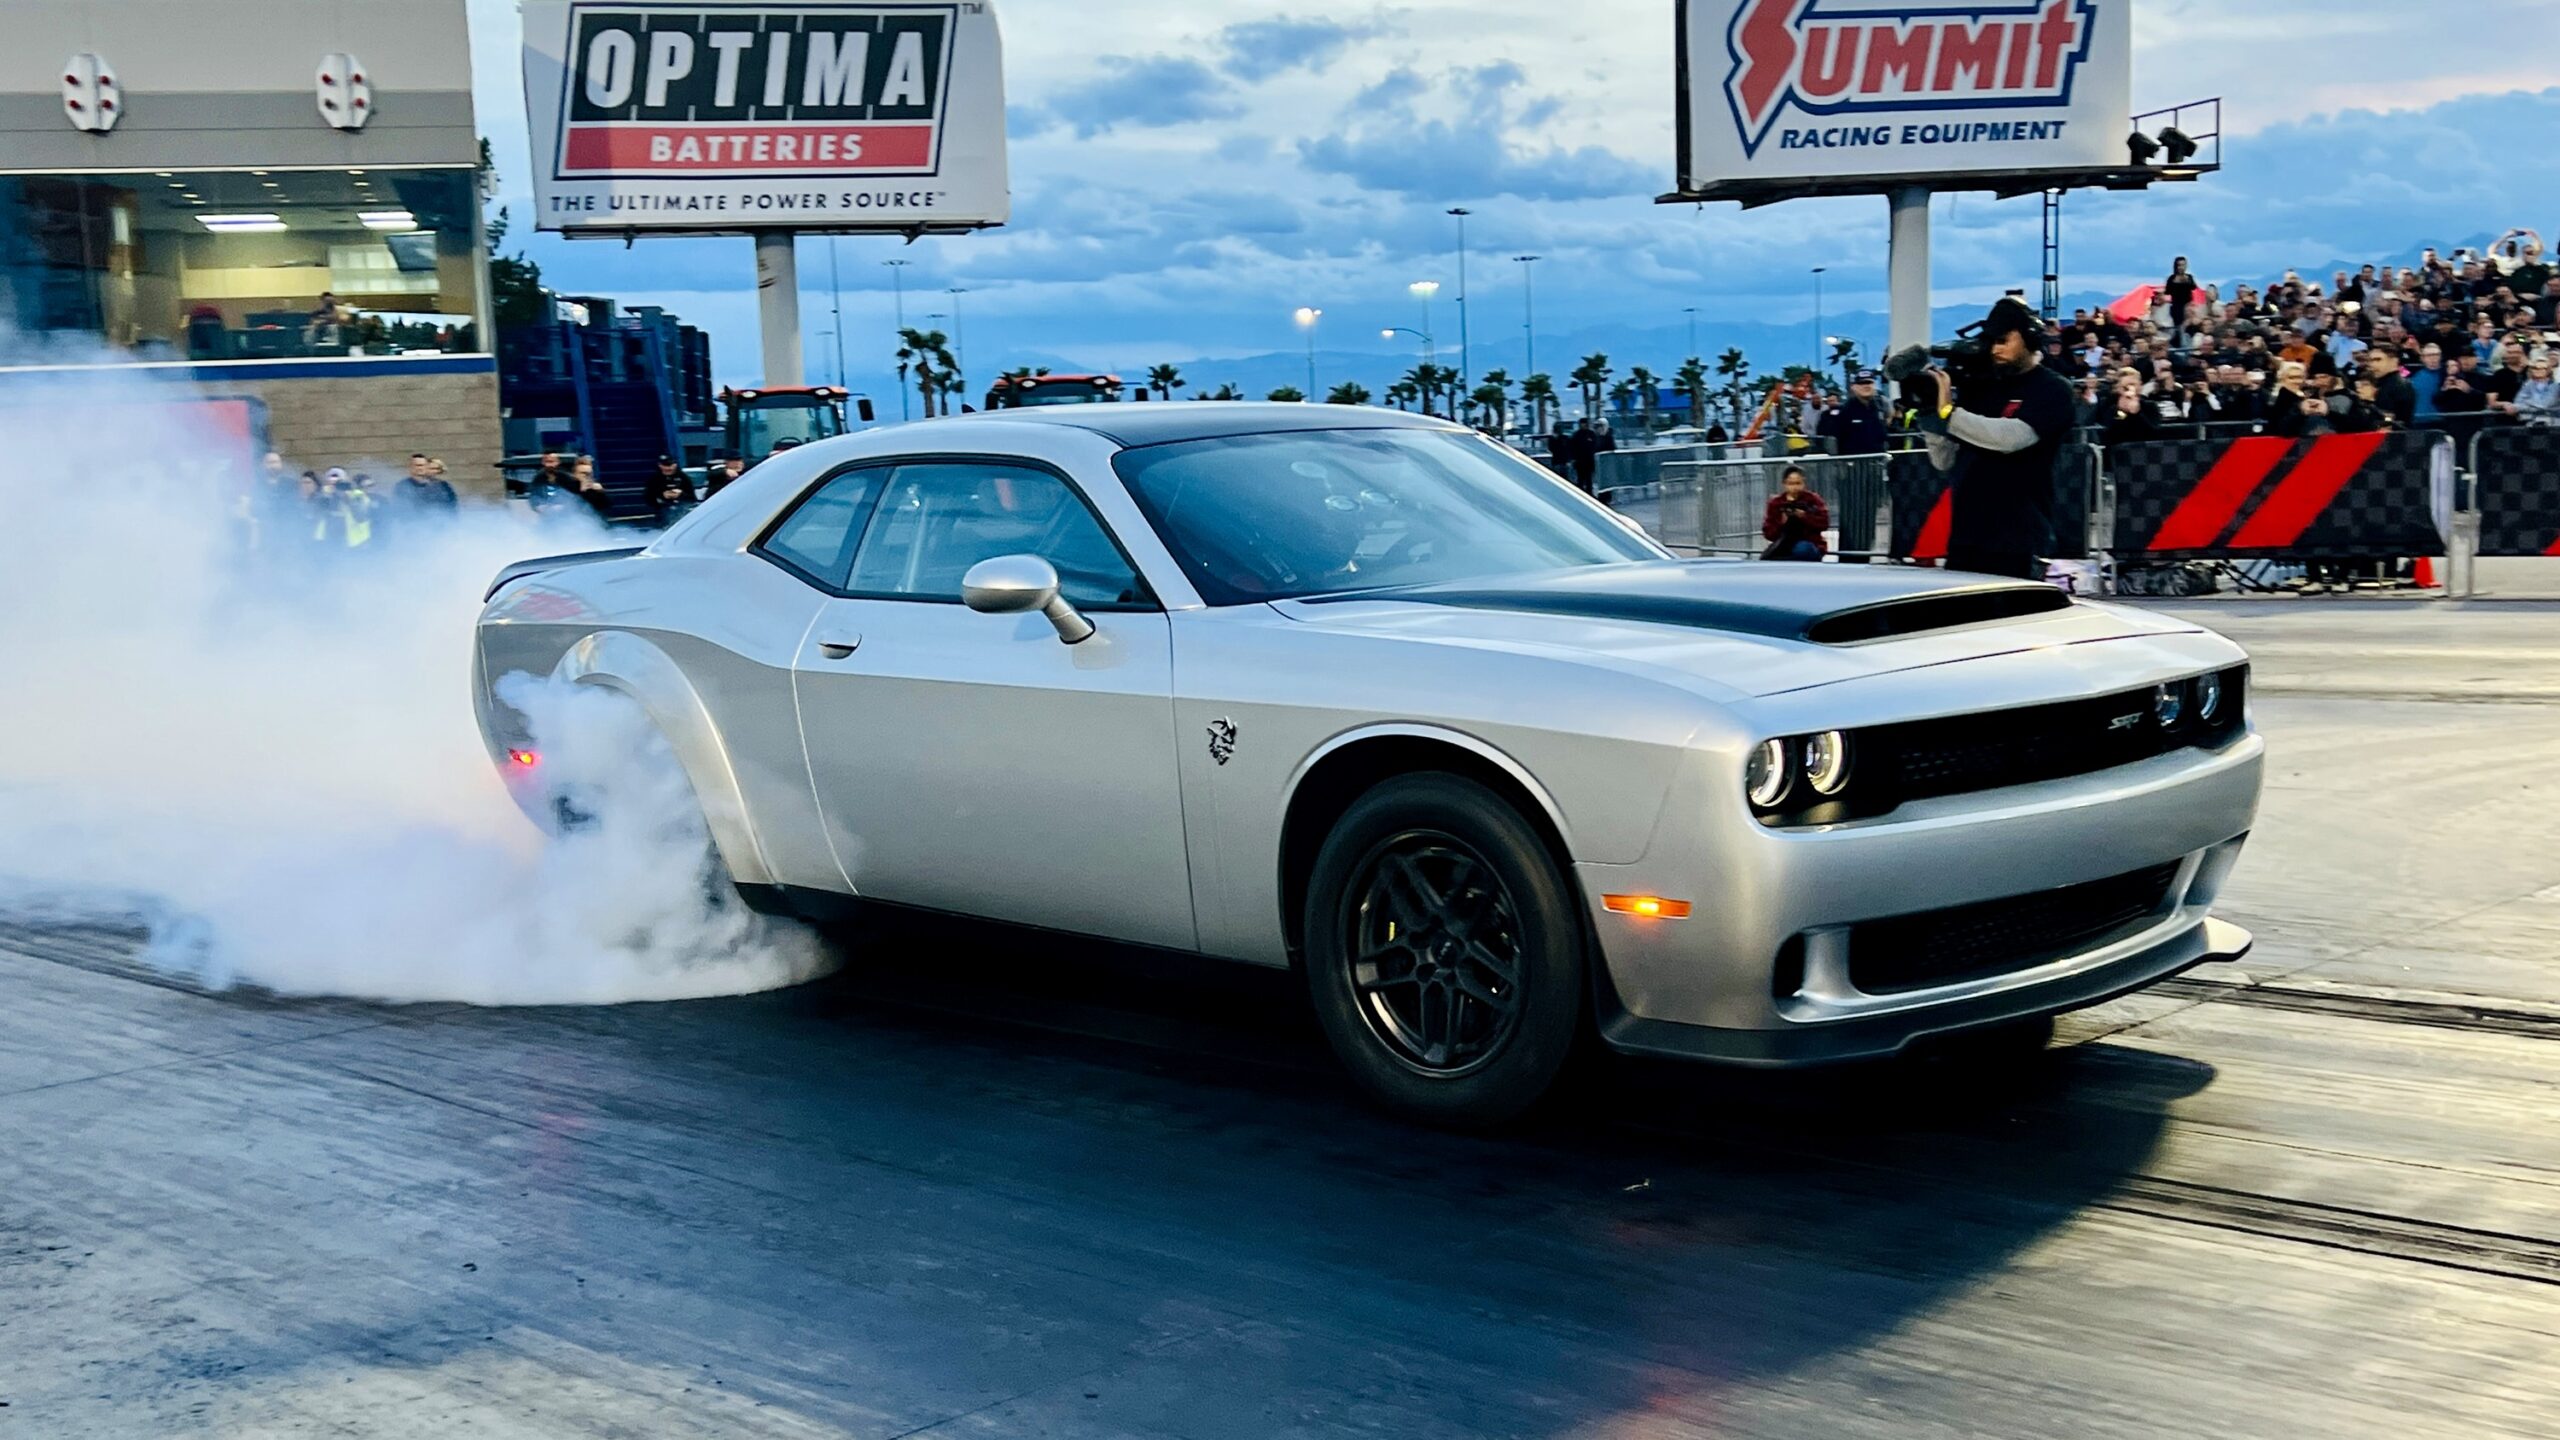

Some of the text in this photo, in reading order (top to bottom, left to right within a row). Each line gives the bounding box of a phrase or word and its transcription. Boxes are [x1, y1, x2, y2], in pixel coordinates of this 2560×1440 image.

[586, 28, 926, 108] OPTIMA
[650, 134, 863, 162] BATTERIES
[1780, 120, 2066, 149] RACING EQUIPMENT
[551, 196, 595, 212] THE
[608, 195, 727, 211] ULTIMATE
[741, 193, 827, 210] POWER
